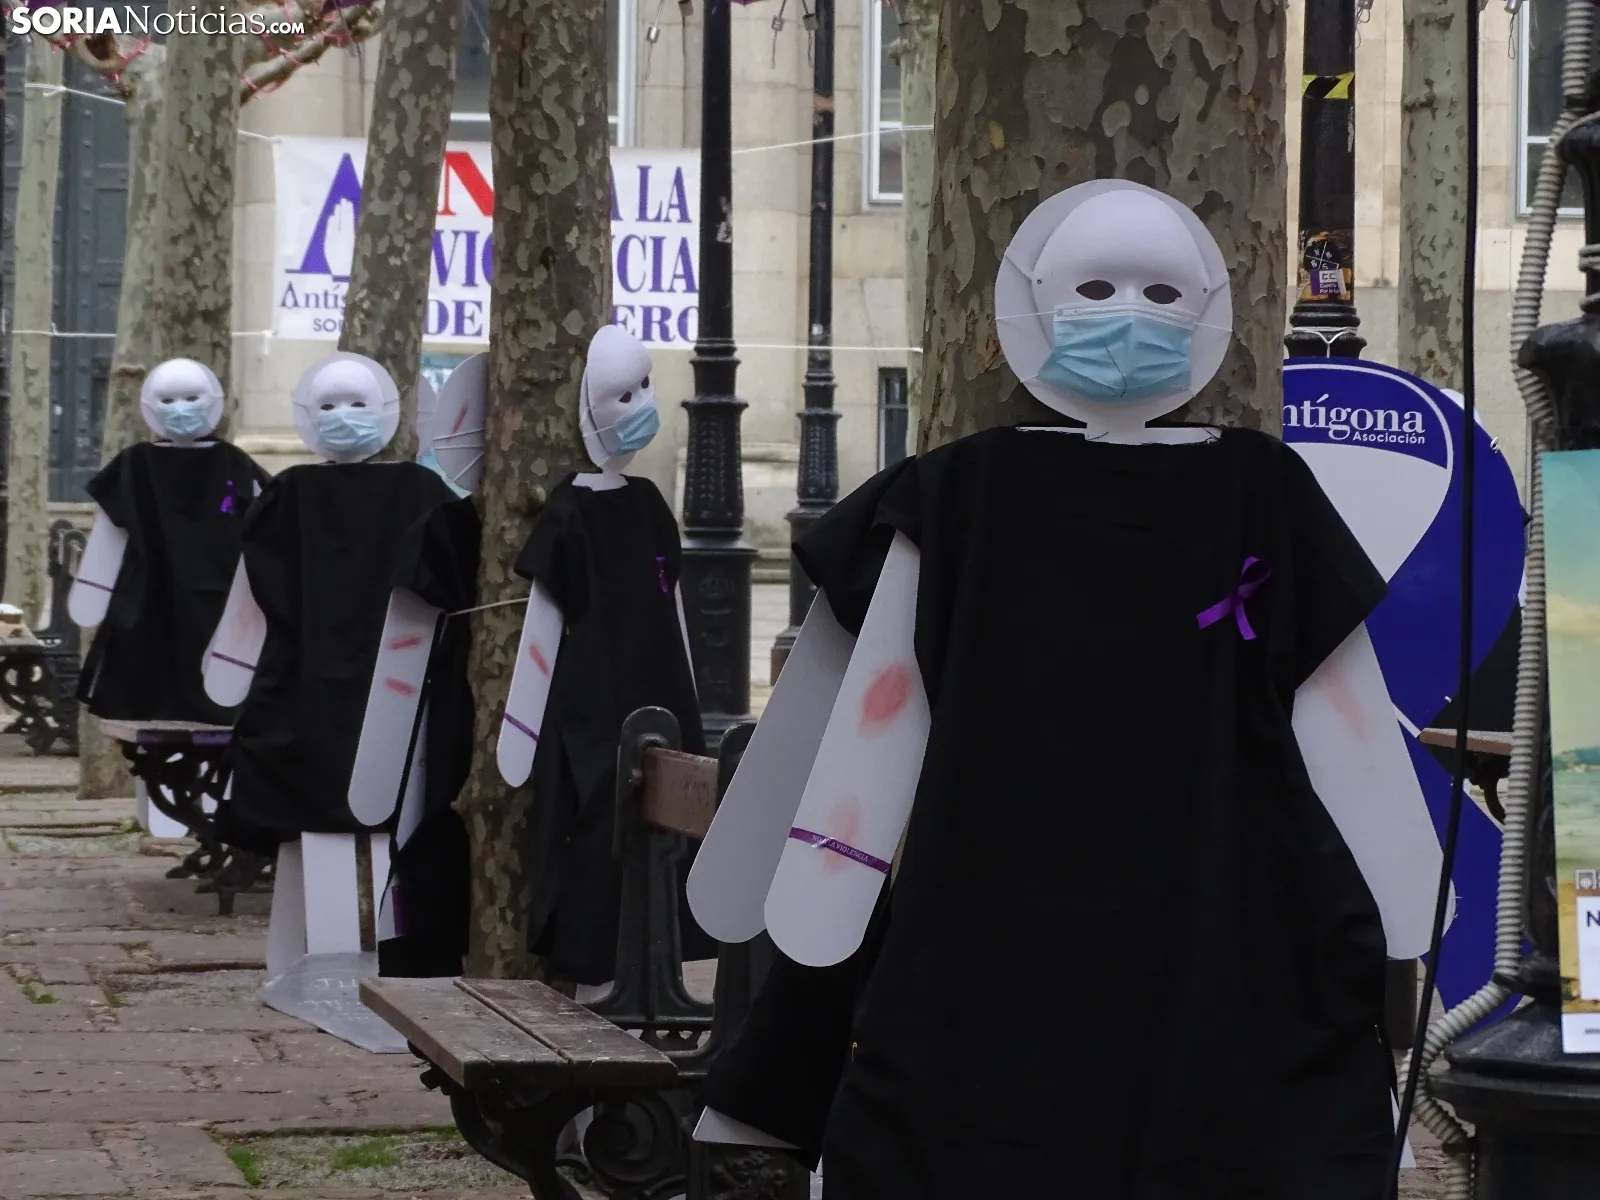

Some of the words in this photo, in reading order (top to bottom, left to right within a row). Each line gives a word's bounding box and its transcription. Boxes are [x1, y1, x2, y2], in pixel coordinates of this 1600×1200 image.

[436, 151, 494, 216] N
[635, 165, 692, 223] LA
[279, 281, 347, 315] Antí
[423, 299, 483, 337] DE
[612, 304, 699, 344] ERO
[1282, 393, 1426, 440] ntígona
[1352, 432, 1426, 445] Asociación
